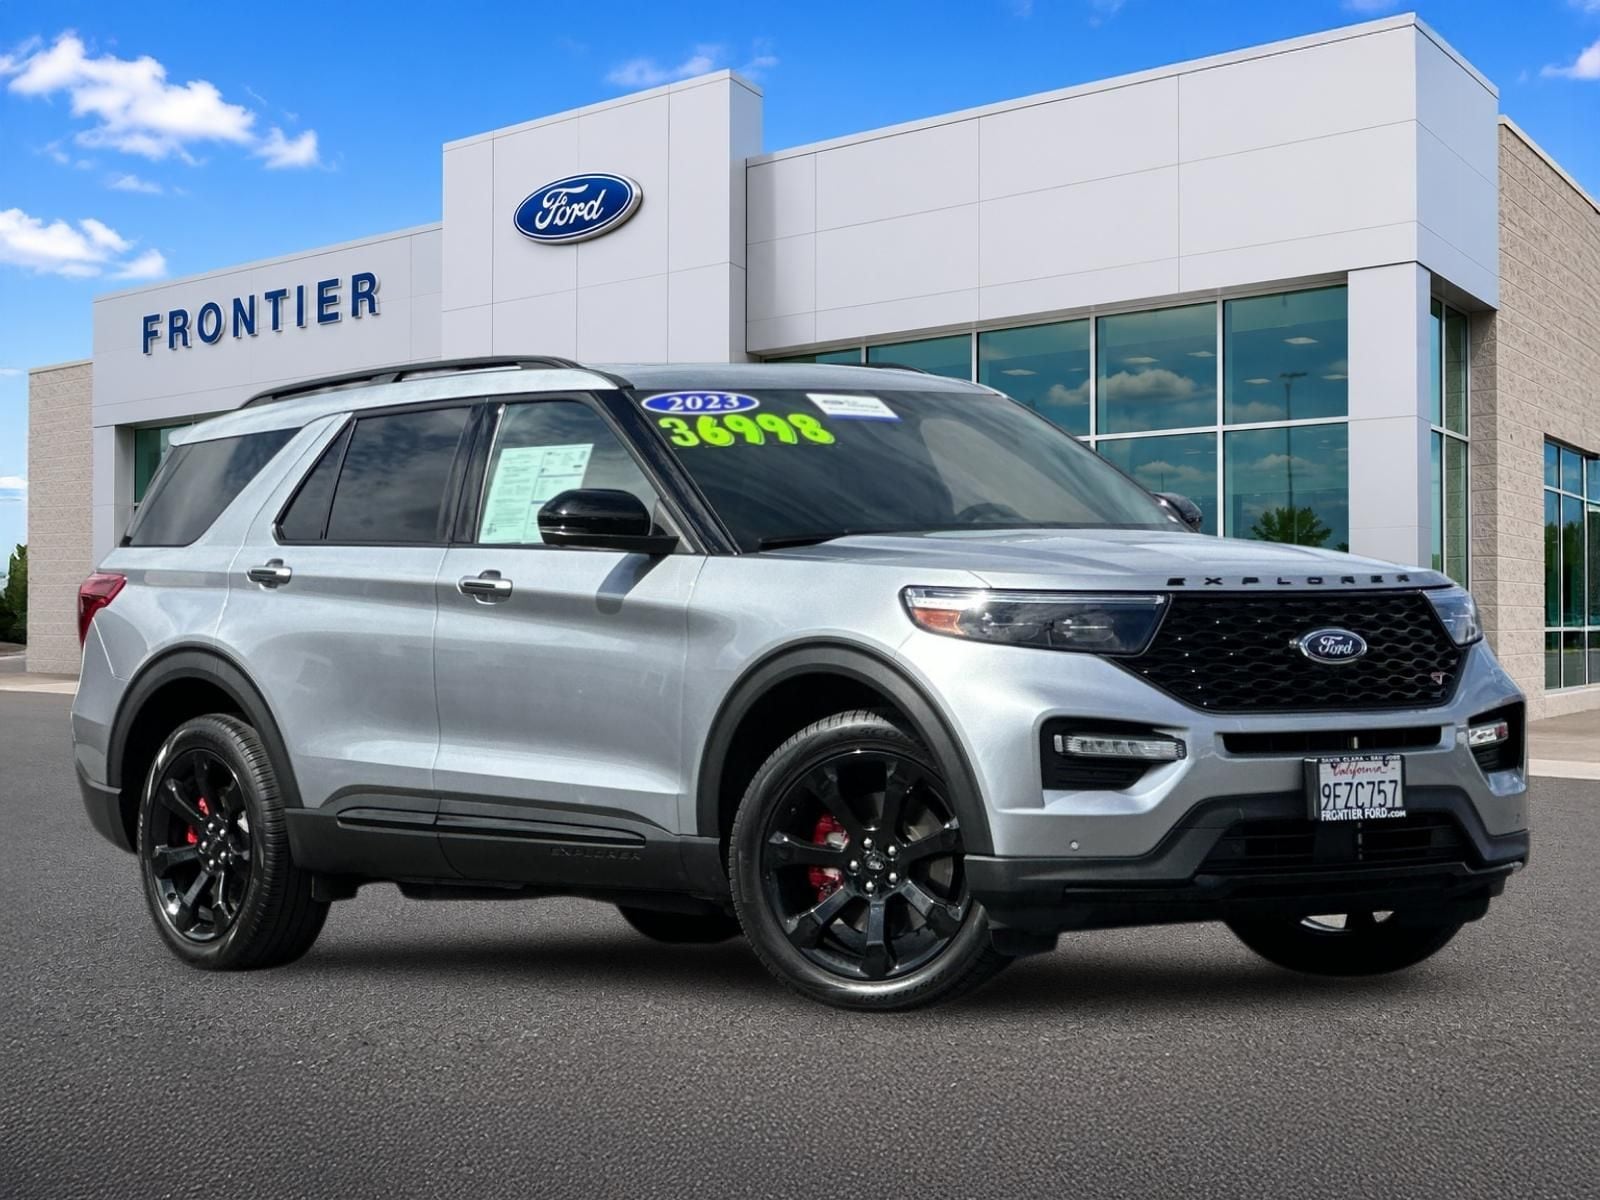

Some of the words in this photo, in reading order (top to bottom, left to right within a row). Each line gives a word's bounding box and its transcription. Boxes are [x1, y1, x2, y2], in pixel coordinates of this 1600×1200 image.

[535, 184, 606, 230] Ford
[141, 271, 381, 356] FRONTIER
[666, 395, 741, 412] 2023
[658, 413, 835, 446] 36998
[1167, 574, 1411, 586] EXPLORER
[1318, 636, 1354, 655] Ford
[1333, 760, 1387, 779] California
[1322, 780, 1398, 810] 9FZC757
[1321, 808, 1363, 821] FRONTIER
